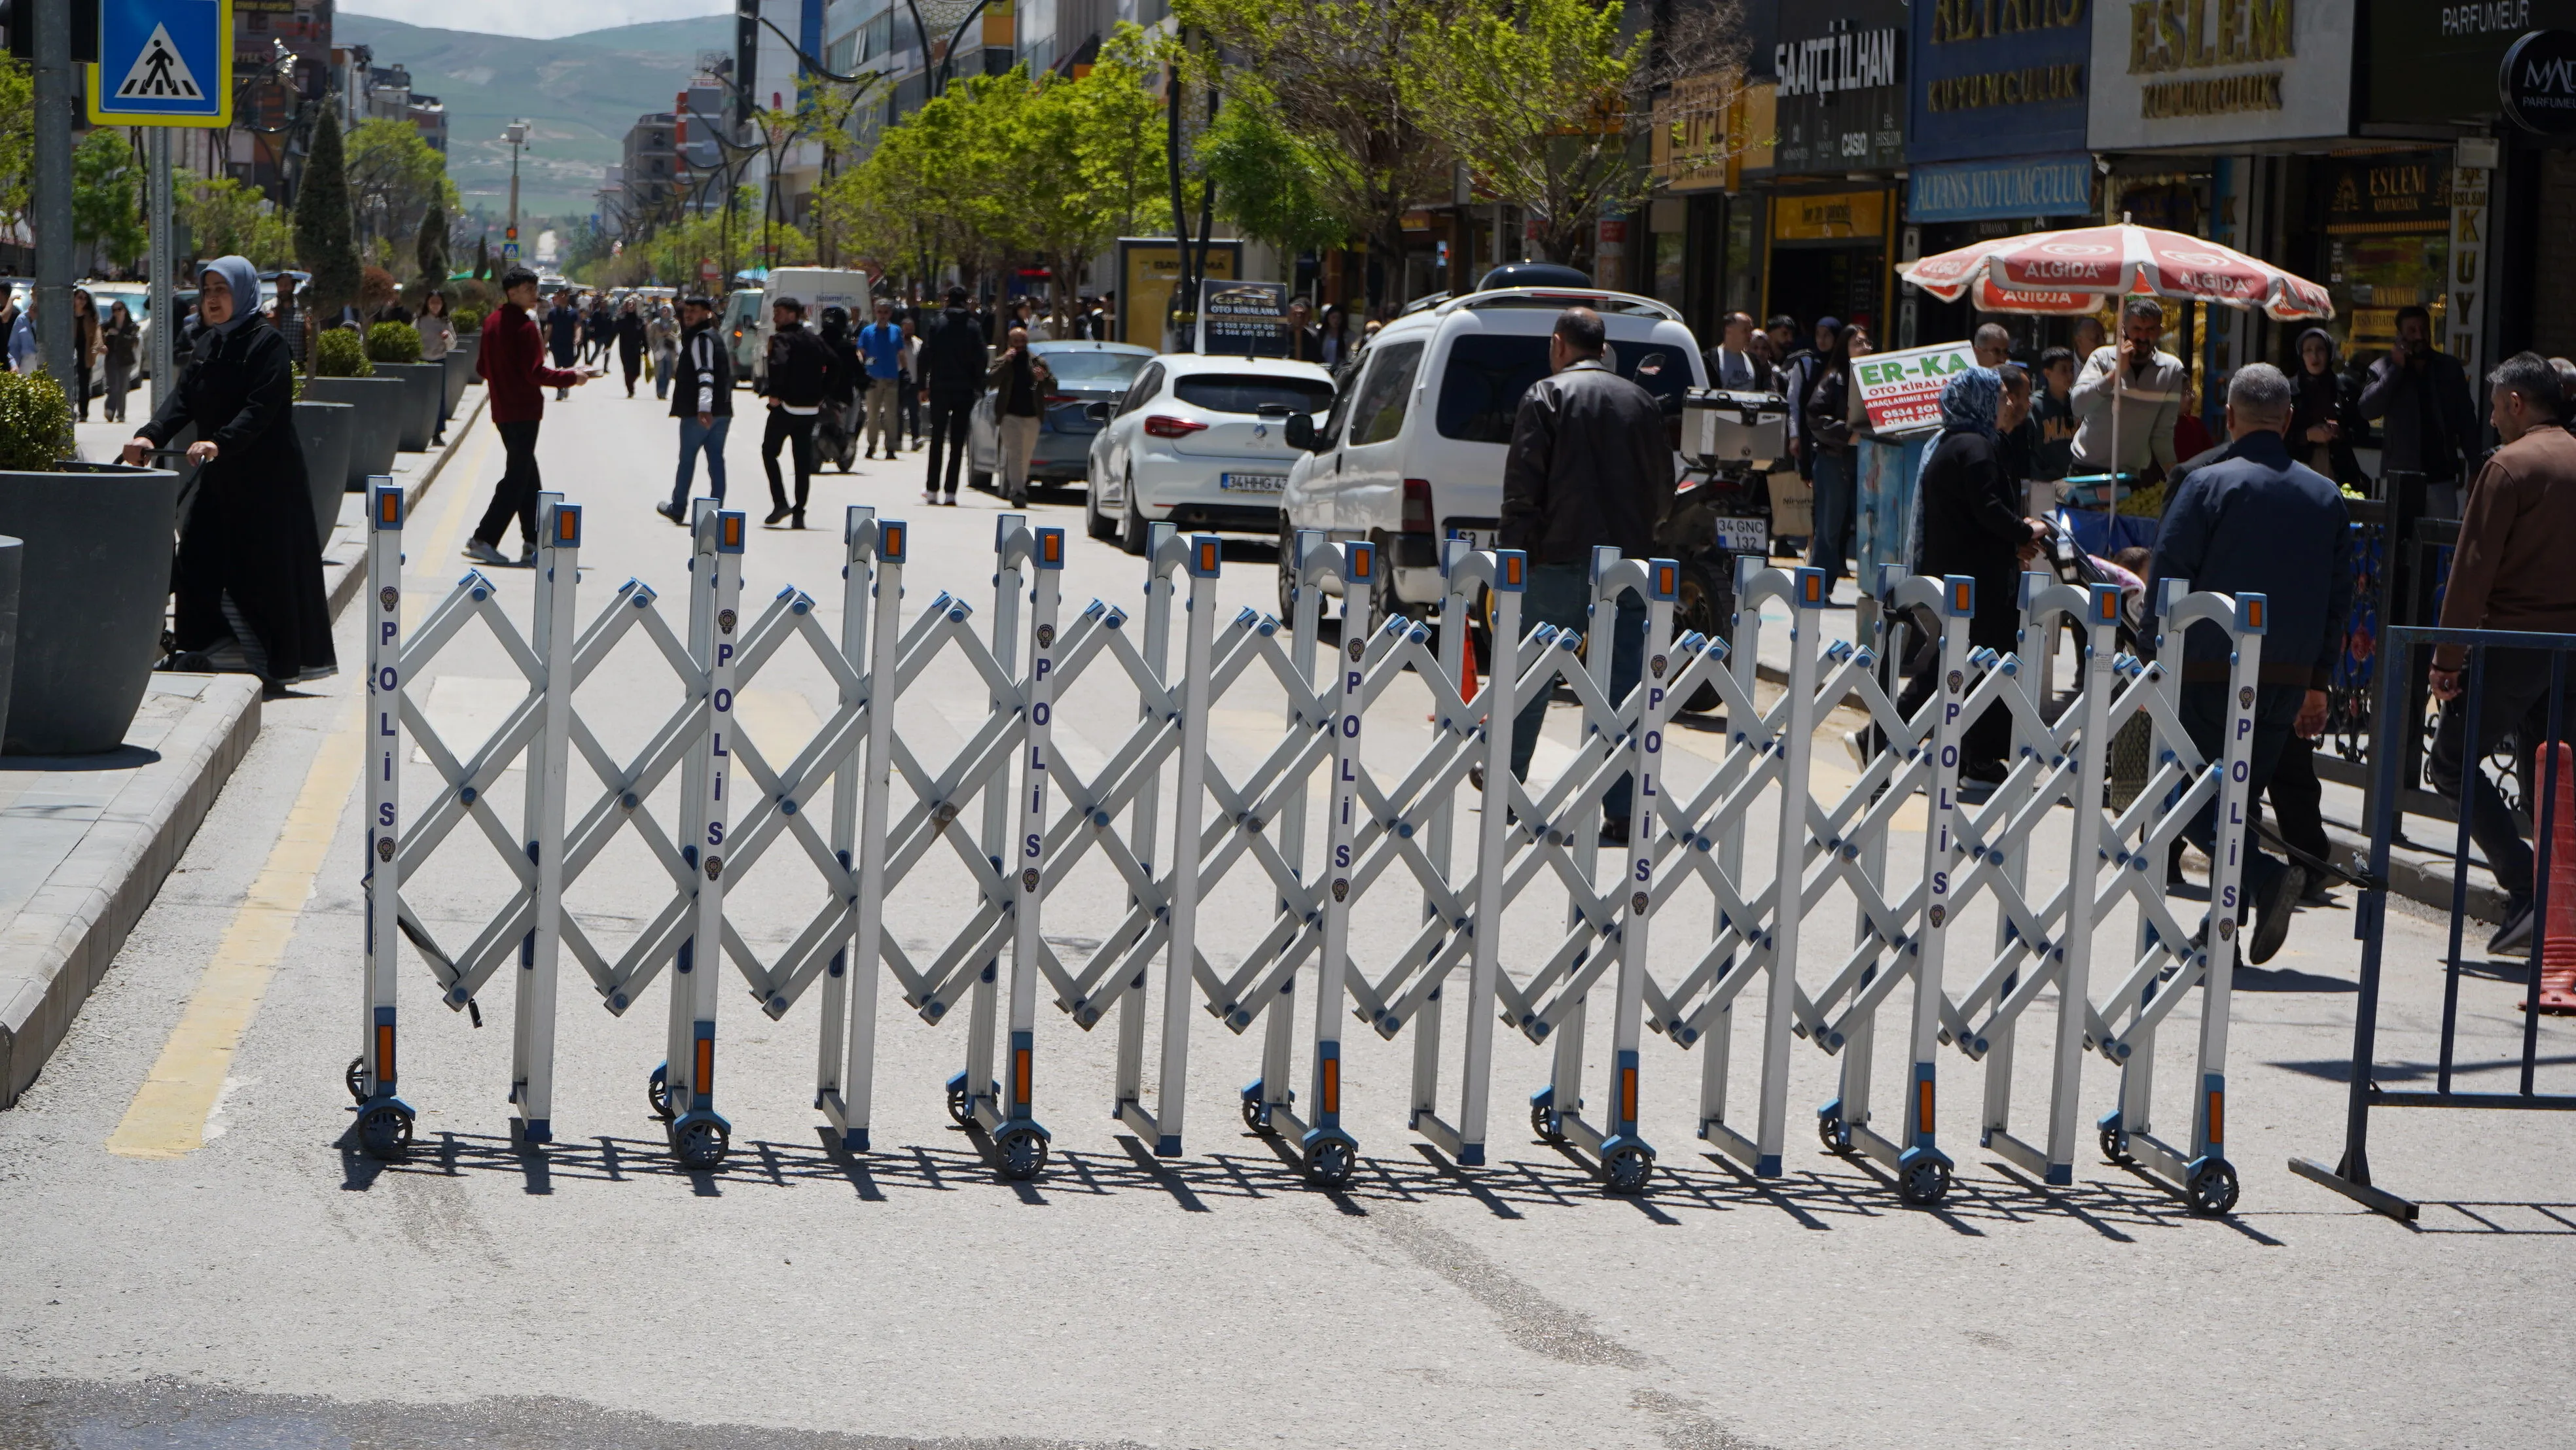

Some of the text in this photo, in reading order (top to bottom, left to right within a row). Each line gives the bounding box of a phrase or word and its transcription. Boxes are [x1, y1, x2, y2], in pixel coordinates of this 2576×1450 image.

[2126, 0, 2295, 75] ESLEM
[2442, 0, 2530, 35] PARFUMEUR
[1774, 18, 1897, 107] SAATÇİ İLHAN
[1927, 63, 2084, 113] KUYUMCULUK
[2140, 70, 2283, 119] KUYUMCULUK
[1842, 132, 1867, 157] CASIO
[1971, 164, 2088, 209] KUYUMCULUK
[2369, 164, 2427, 196] ESLEM
[2454, 209, 2480, 380] KUYU
[1859, 353, 1969, 386] ER-KA
[1869, 378, 1957, 396] OTO KİRALA
[1719, 520, 1763, 534] 34 GNC
[1736, 533, 1757, 550] 132
[379, 622, 397, 826] POLİS
[708, 644, 733, 844] POLİS
[1026, 658, 1051, 858] POLİS
[1335, 671, 1362, 868] POLİS
[1636, 688, 1664, 881] POLİS
[1933, 703, 1961, 894] POLİS
[2223, 718, 2251, 908] POLİS
